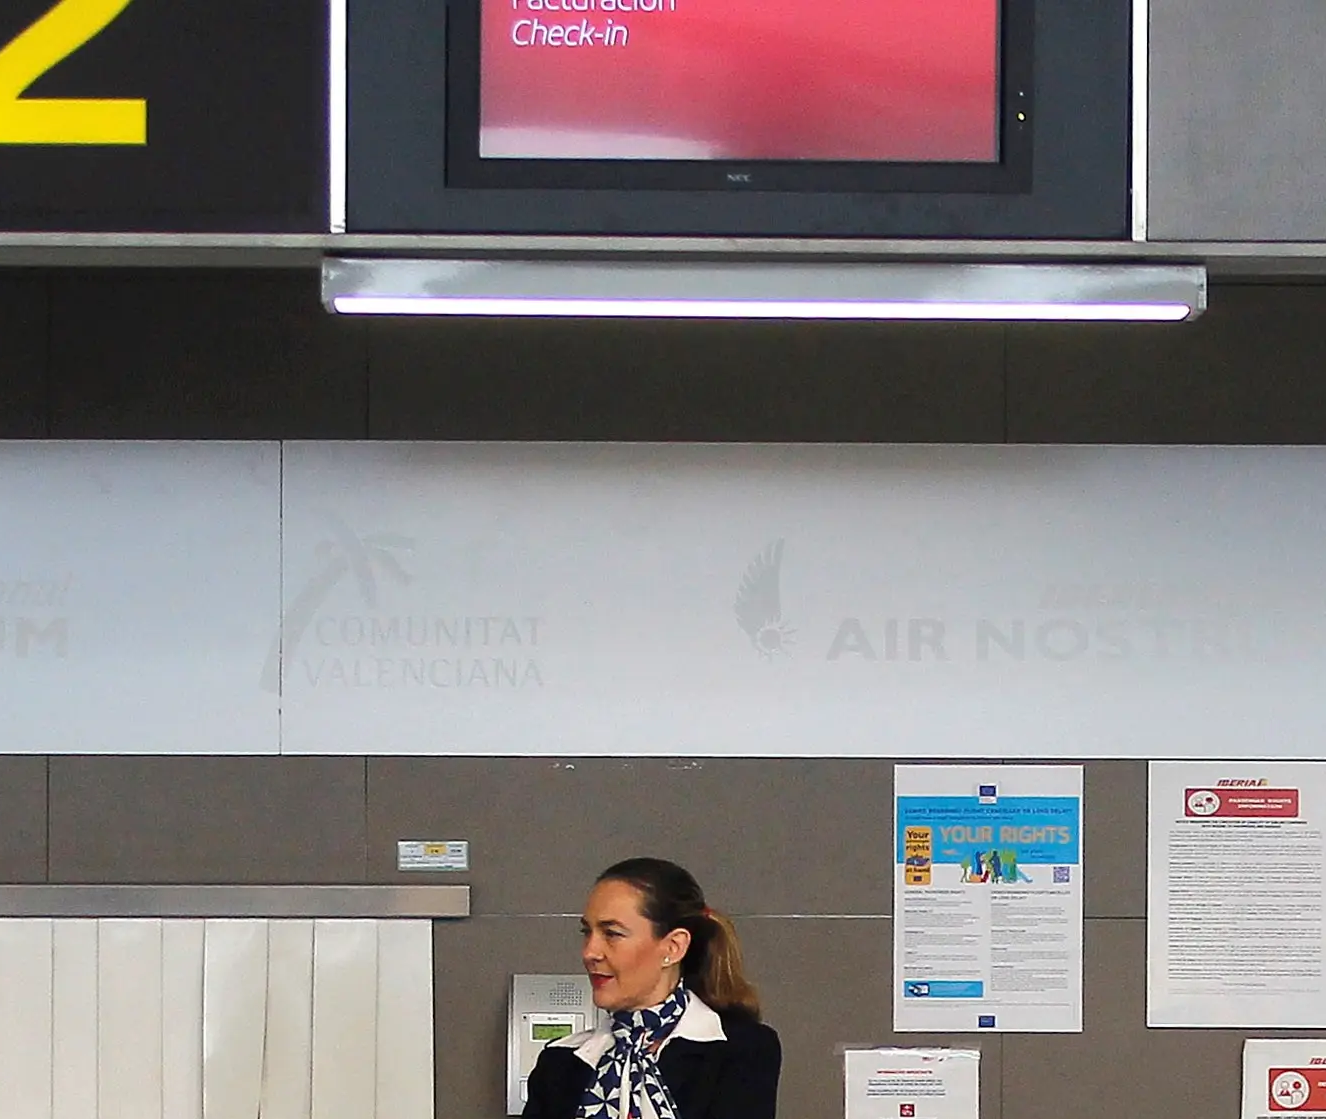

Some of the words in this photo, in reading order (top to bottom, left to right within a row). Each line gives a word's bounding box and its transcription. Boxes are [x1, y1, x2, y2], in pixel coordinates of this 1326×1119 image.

[512, 19, 629, 47] Check-in
[825, 617, 950, 662] AIR
[940, 825, 994, 844] YOUR
[1000, 825, 1071, 845] RIGHTS
